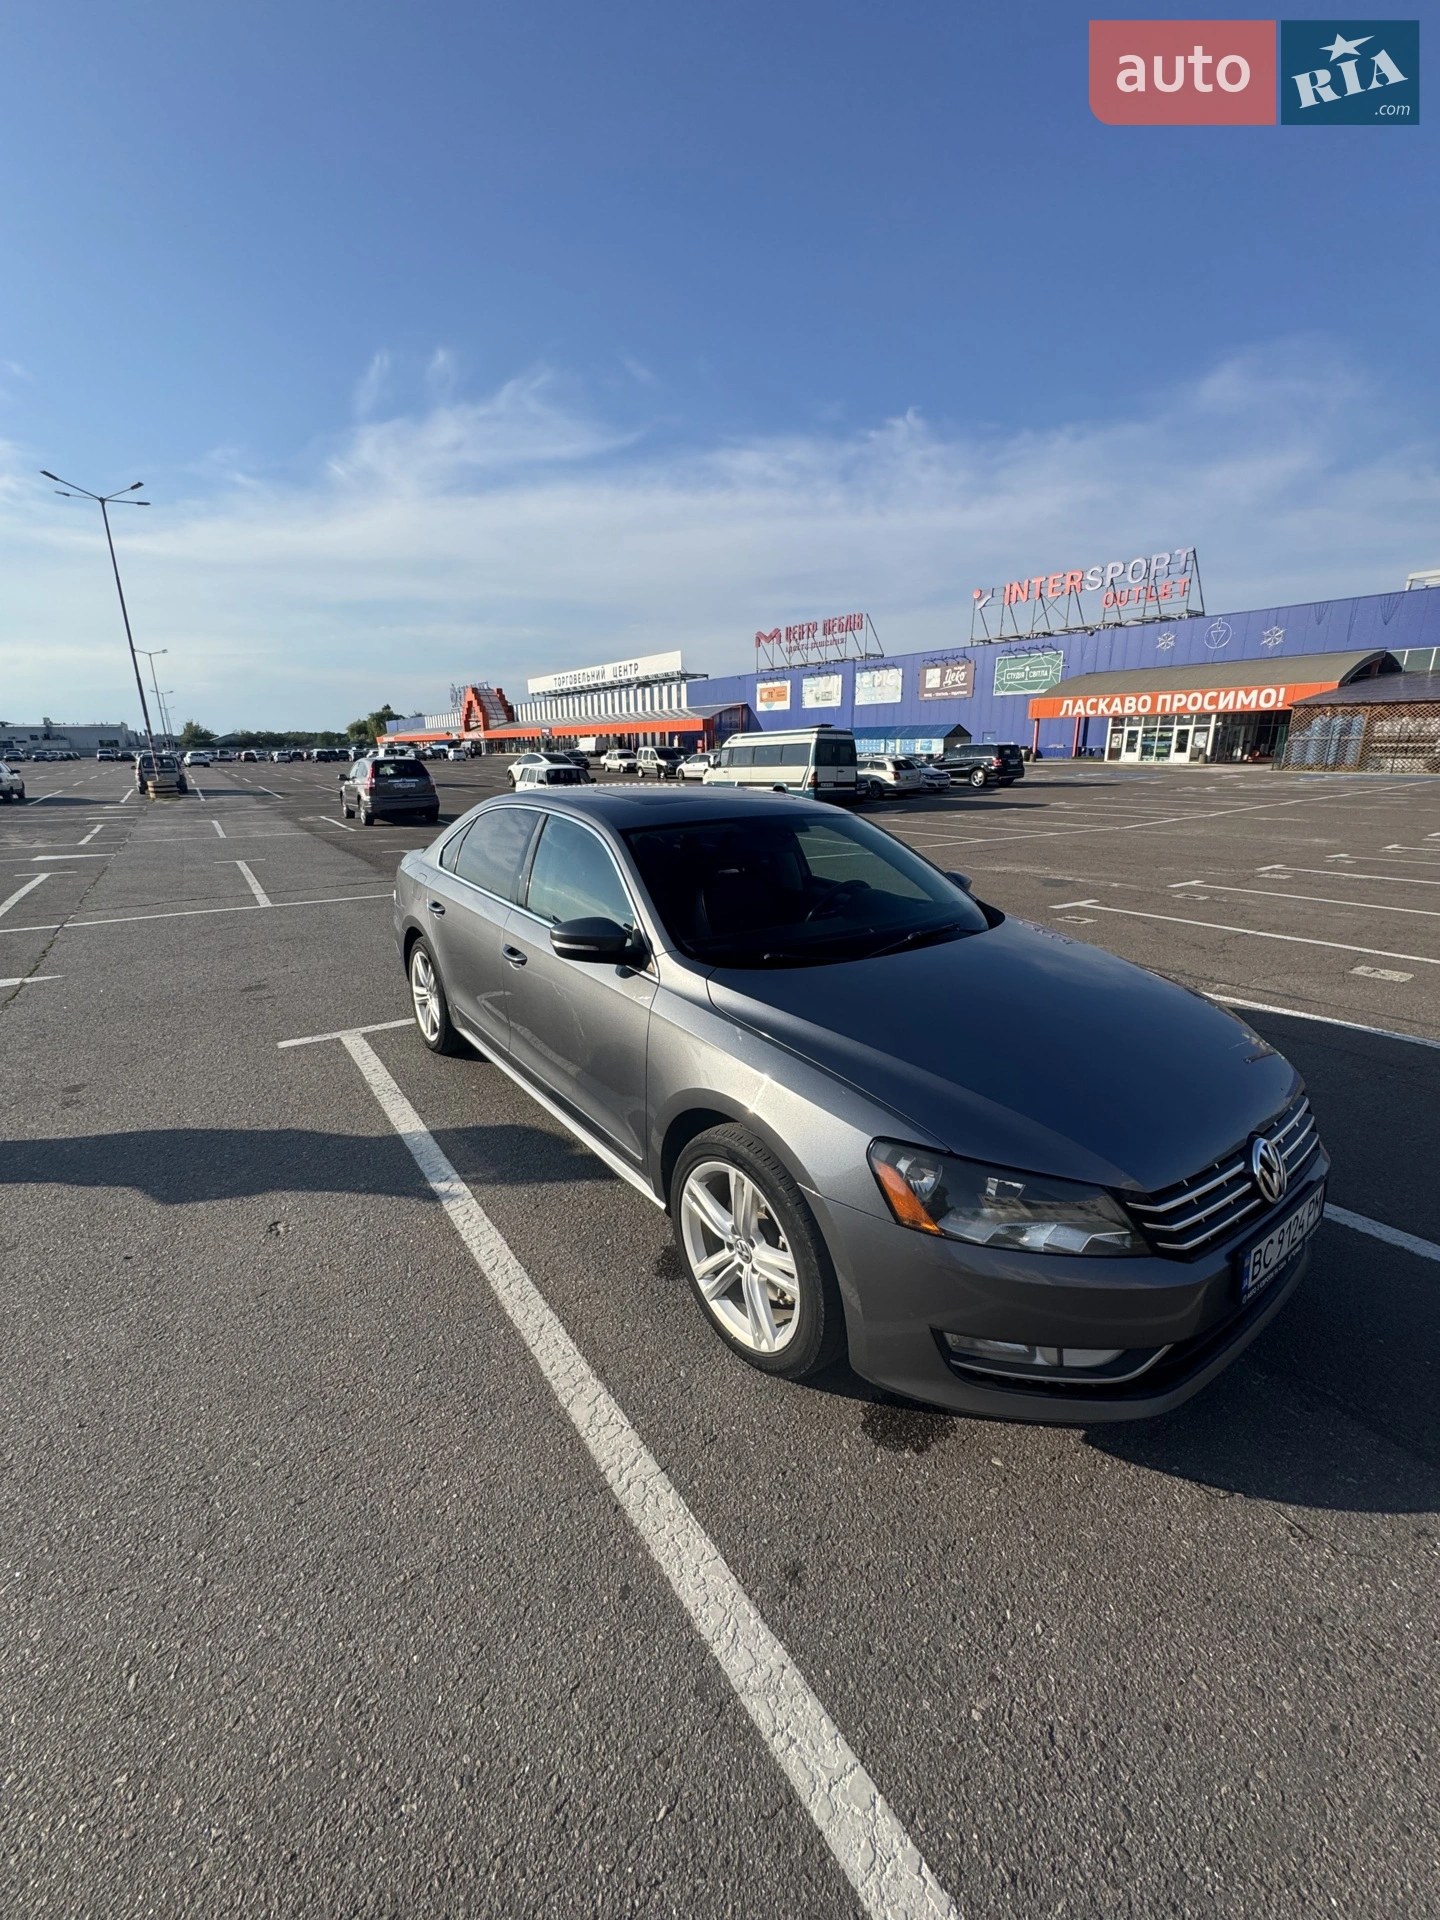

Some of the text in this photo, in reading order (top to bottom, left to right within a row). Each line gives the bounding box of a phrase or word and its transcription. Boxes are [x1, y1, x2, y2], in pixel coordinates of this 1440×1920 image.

[1003, 547, 1195, 607] INTERSPORT
[1102, 578, 1192, 609] OUTLET
[785, 613, 863, 643] ЦЕНТР МЕБЛІВ
[553, 662, 639, 688] ТОРГОВЕЛЬНИЙ ЦЕНТР
[1006, 670, 1048, 680] СТУДІЯ СВІТЛА
[1060, 687, 1286, 716] ЛАСКАВО ПРОСИМО!
[1251, 1239, 1274, 1282] BC
[1276, 1207, 1306, 1259] 9124
